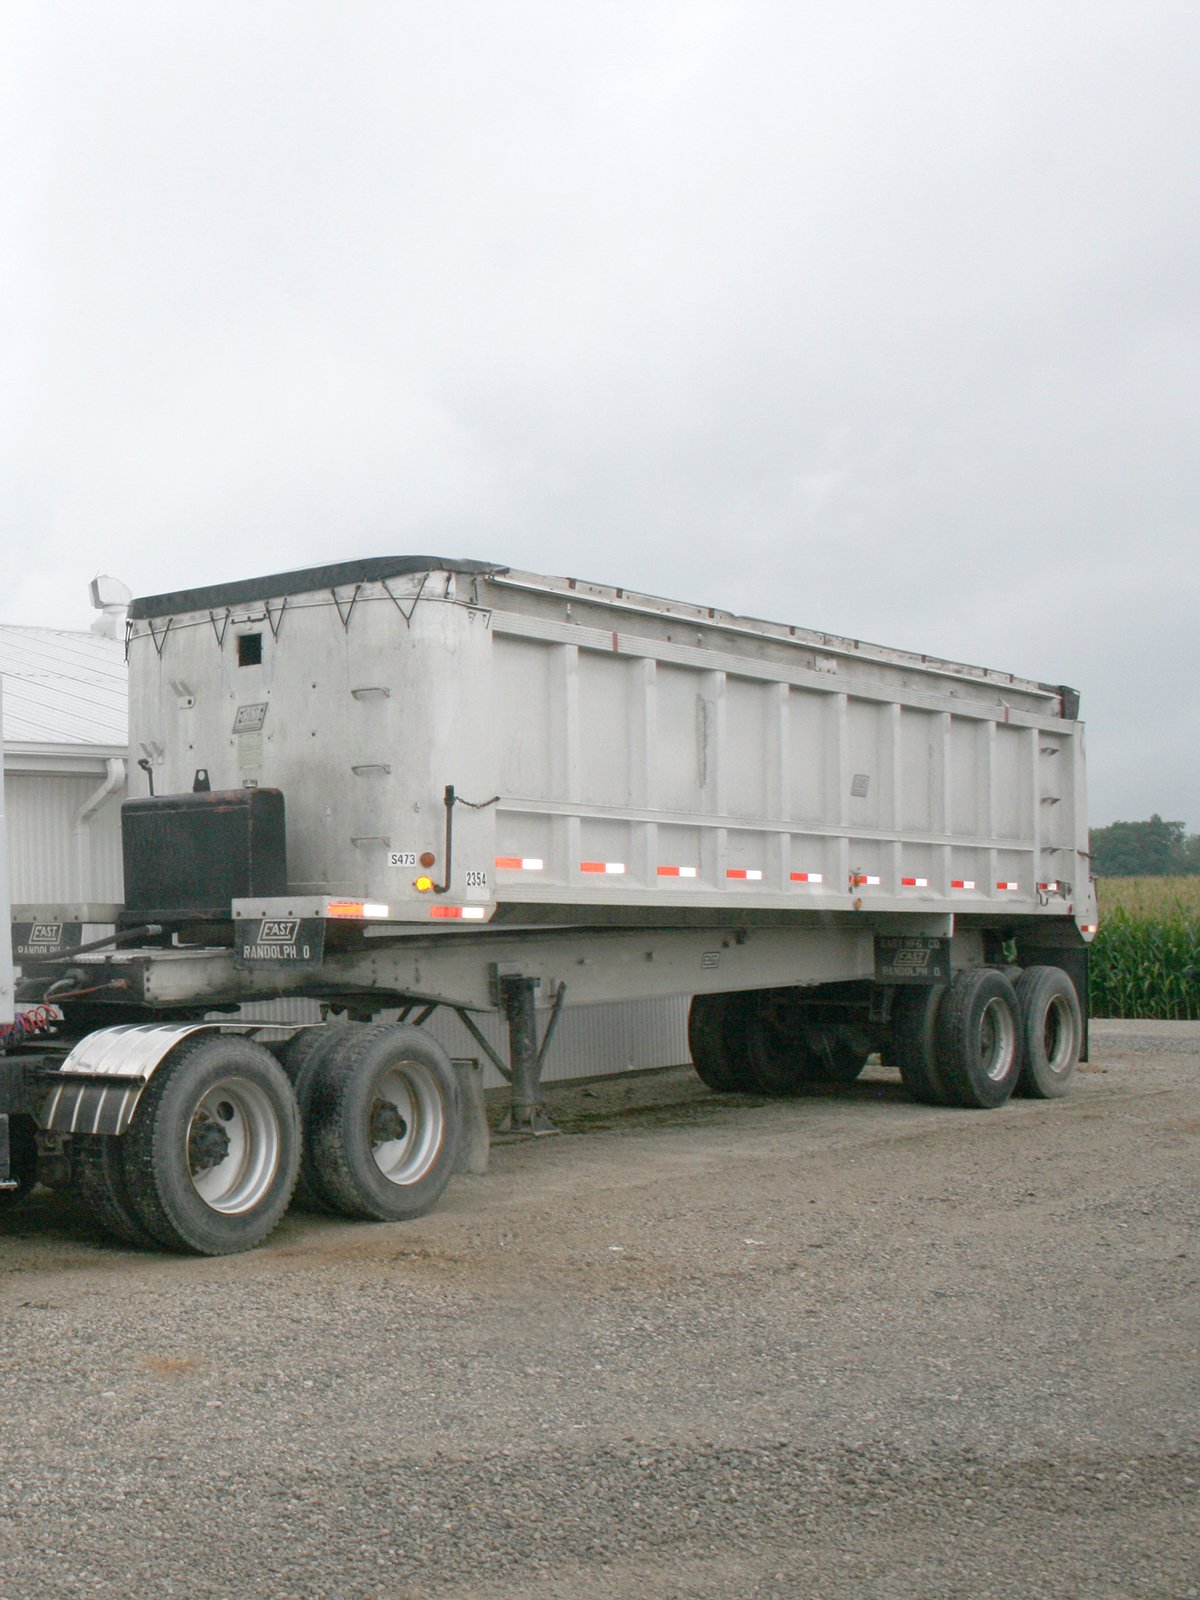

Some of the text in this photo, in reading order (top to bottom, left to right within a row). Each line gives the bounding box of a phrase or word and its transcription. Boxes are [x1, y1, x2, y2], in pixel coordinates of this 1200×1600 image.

[391, 854, 416, 865] S473
[466, 872, 487, 887] 2354
[32, 926, 58, 941] EAST
[262, 923, 293, 939] EAST
[243, 945, 297, 959] RANDOLPH
